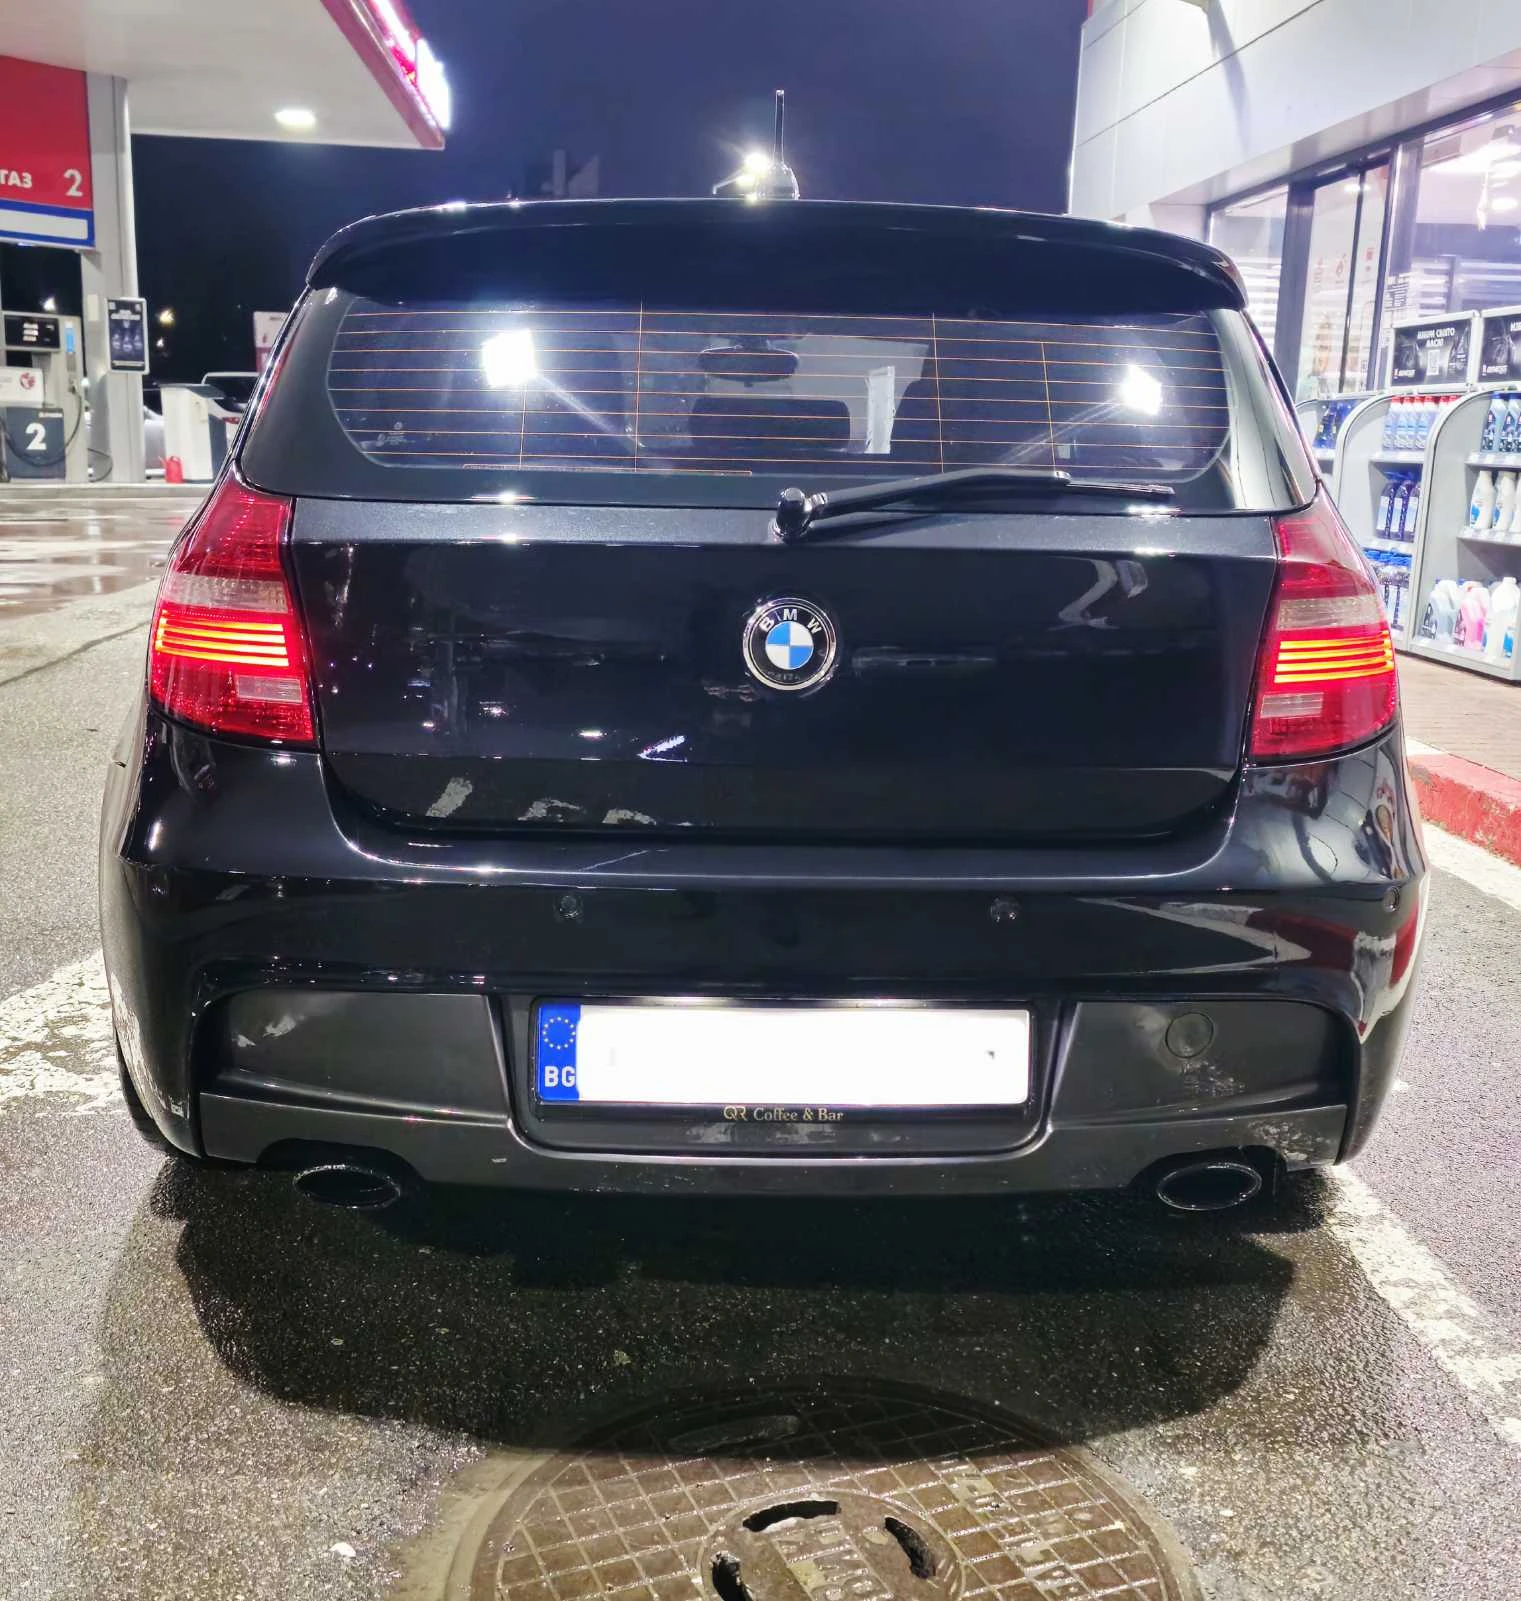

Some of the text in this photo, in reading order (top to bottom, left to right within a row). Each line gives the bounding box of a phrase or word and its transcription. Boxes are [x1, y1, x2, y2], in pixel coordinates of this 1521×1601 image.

[63, 168, 84, 197] 2
[25, 422, 47, 450] 2
[759, 608, 822, 634] BMW
[544, 1065, 576, 1088] BG
[723, 1105, 844, 1121] QR Coffee & Bar
